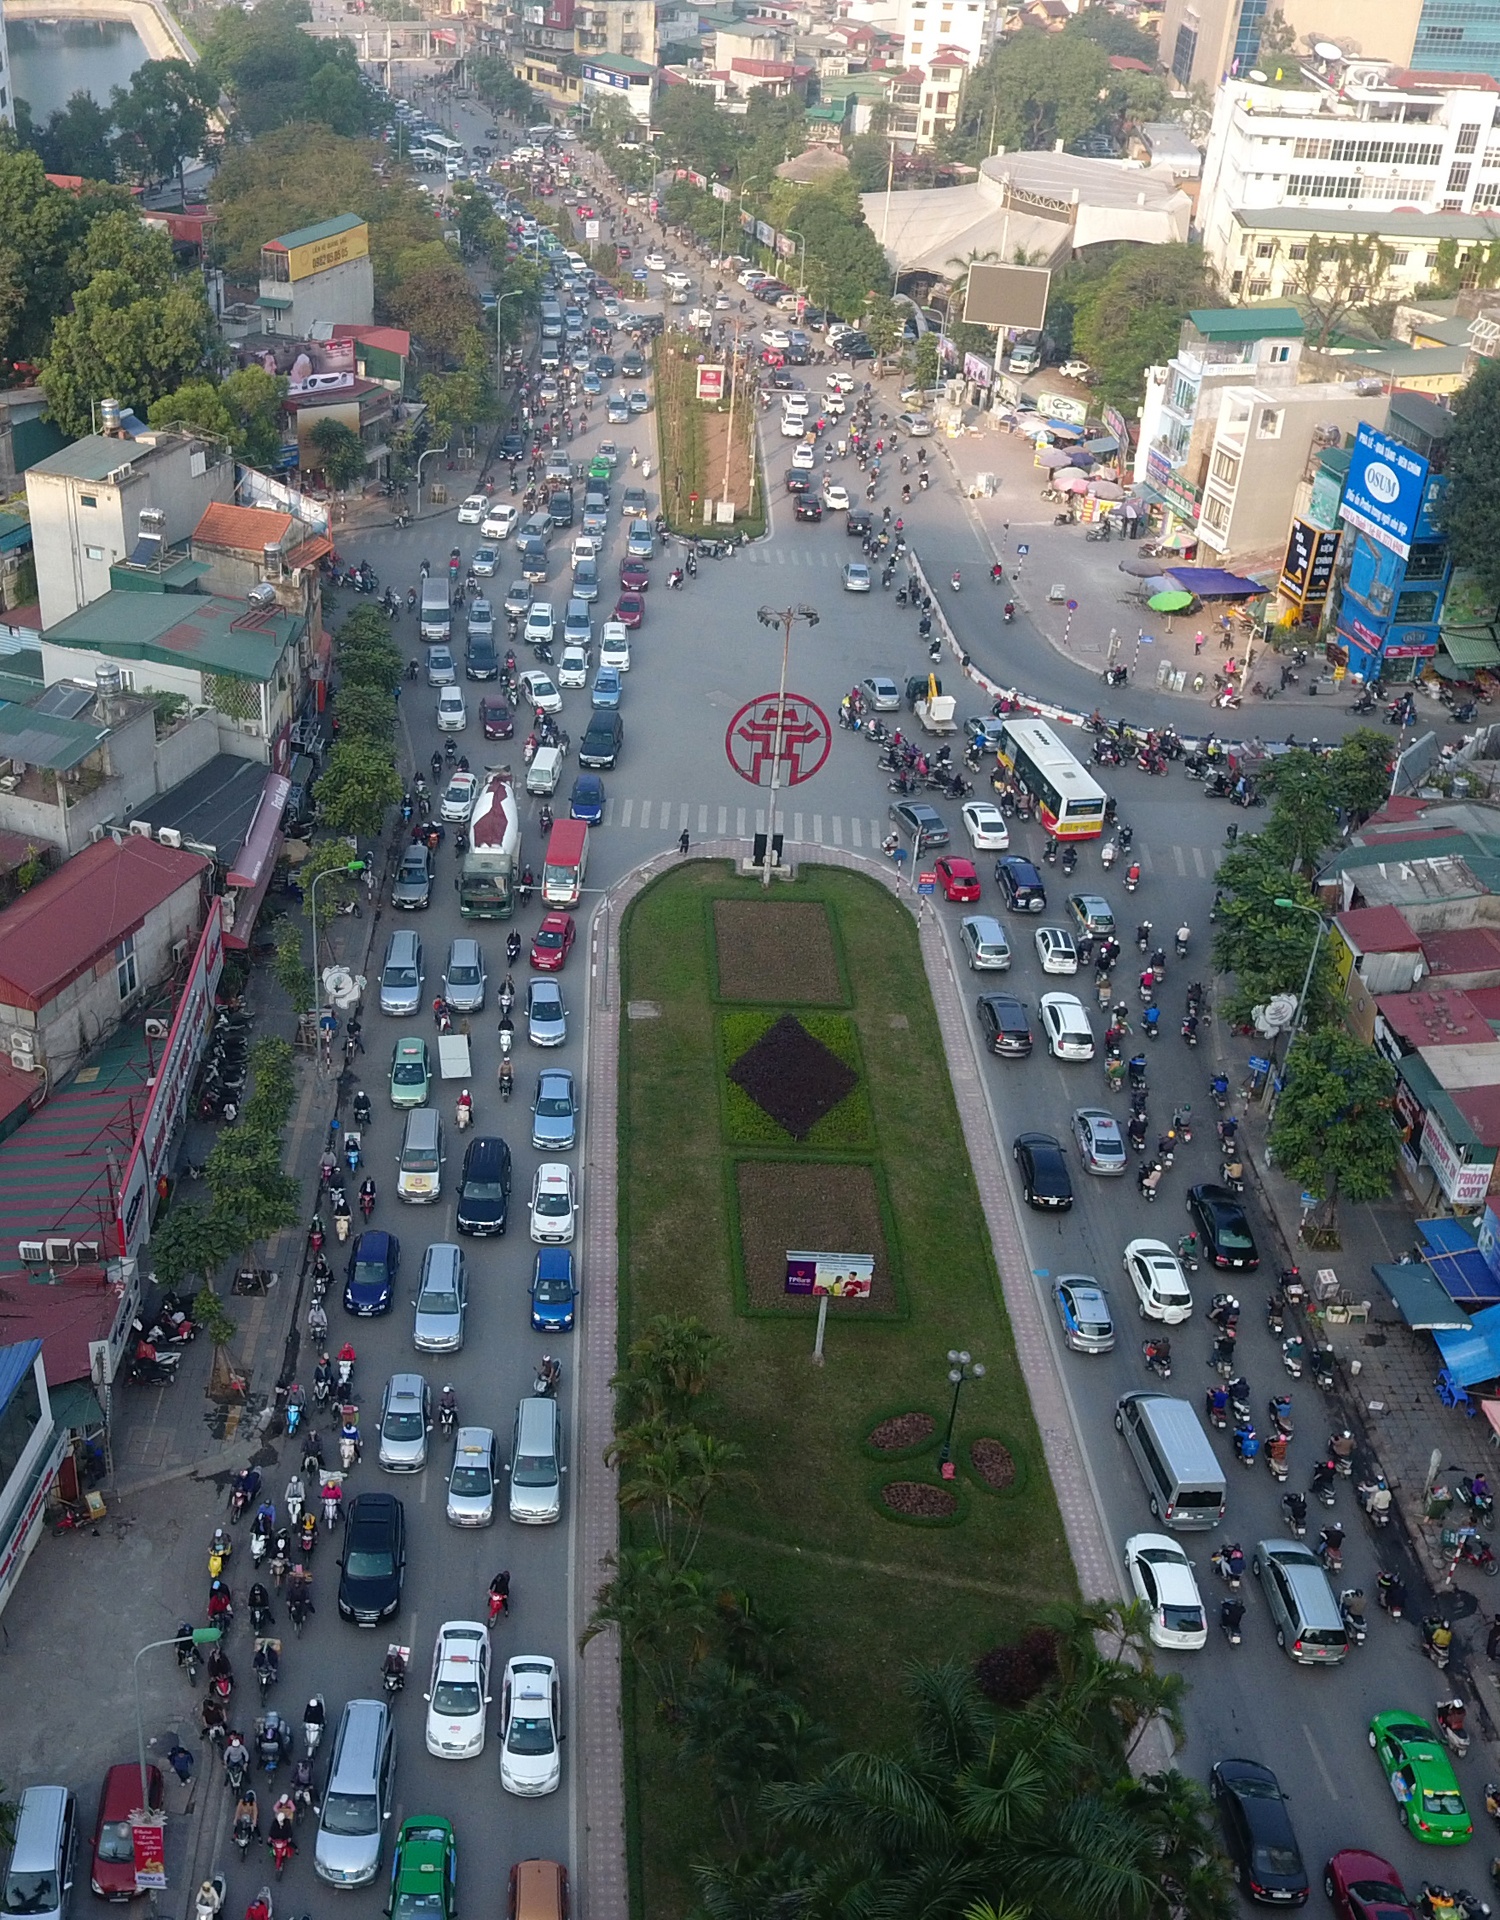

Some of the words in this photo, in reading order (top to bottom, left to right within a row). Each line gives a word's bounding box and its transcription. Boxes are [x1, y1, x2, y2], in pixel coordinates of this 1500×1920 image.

[1368, 468, 1396, 497] OSUM
[1458, 1173, 1488, 1184] PHOTO
[1458, 1187, 1482, 1198] COPY
